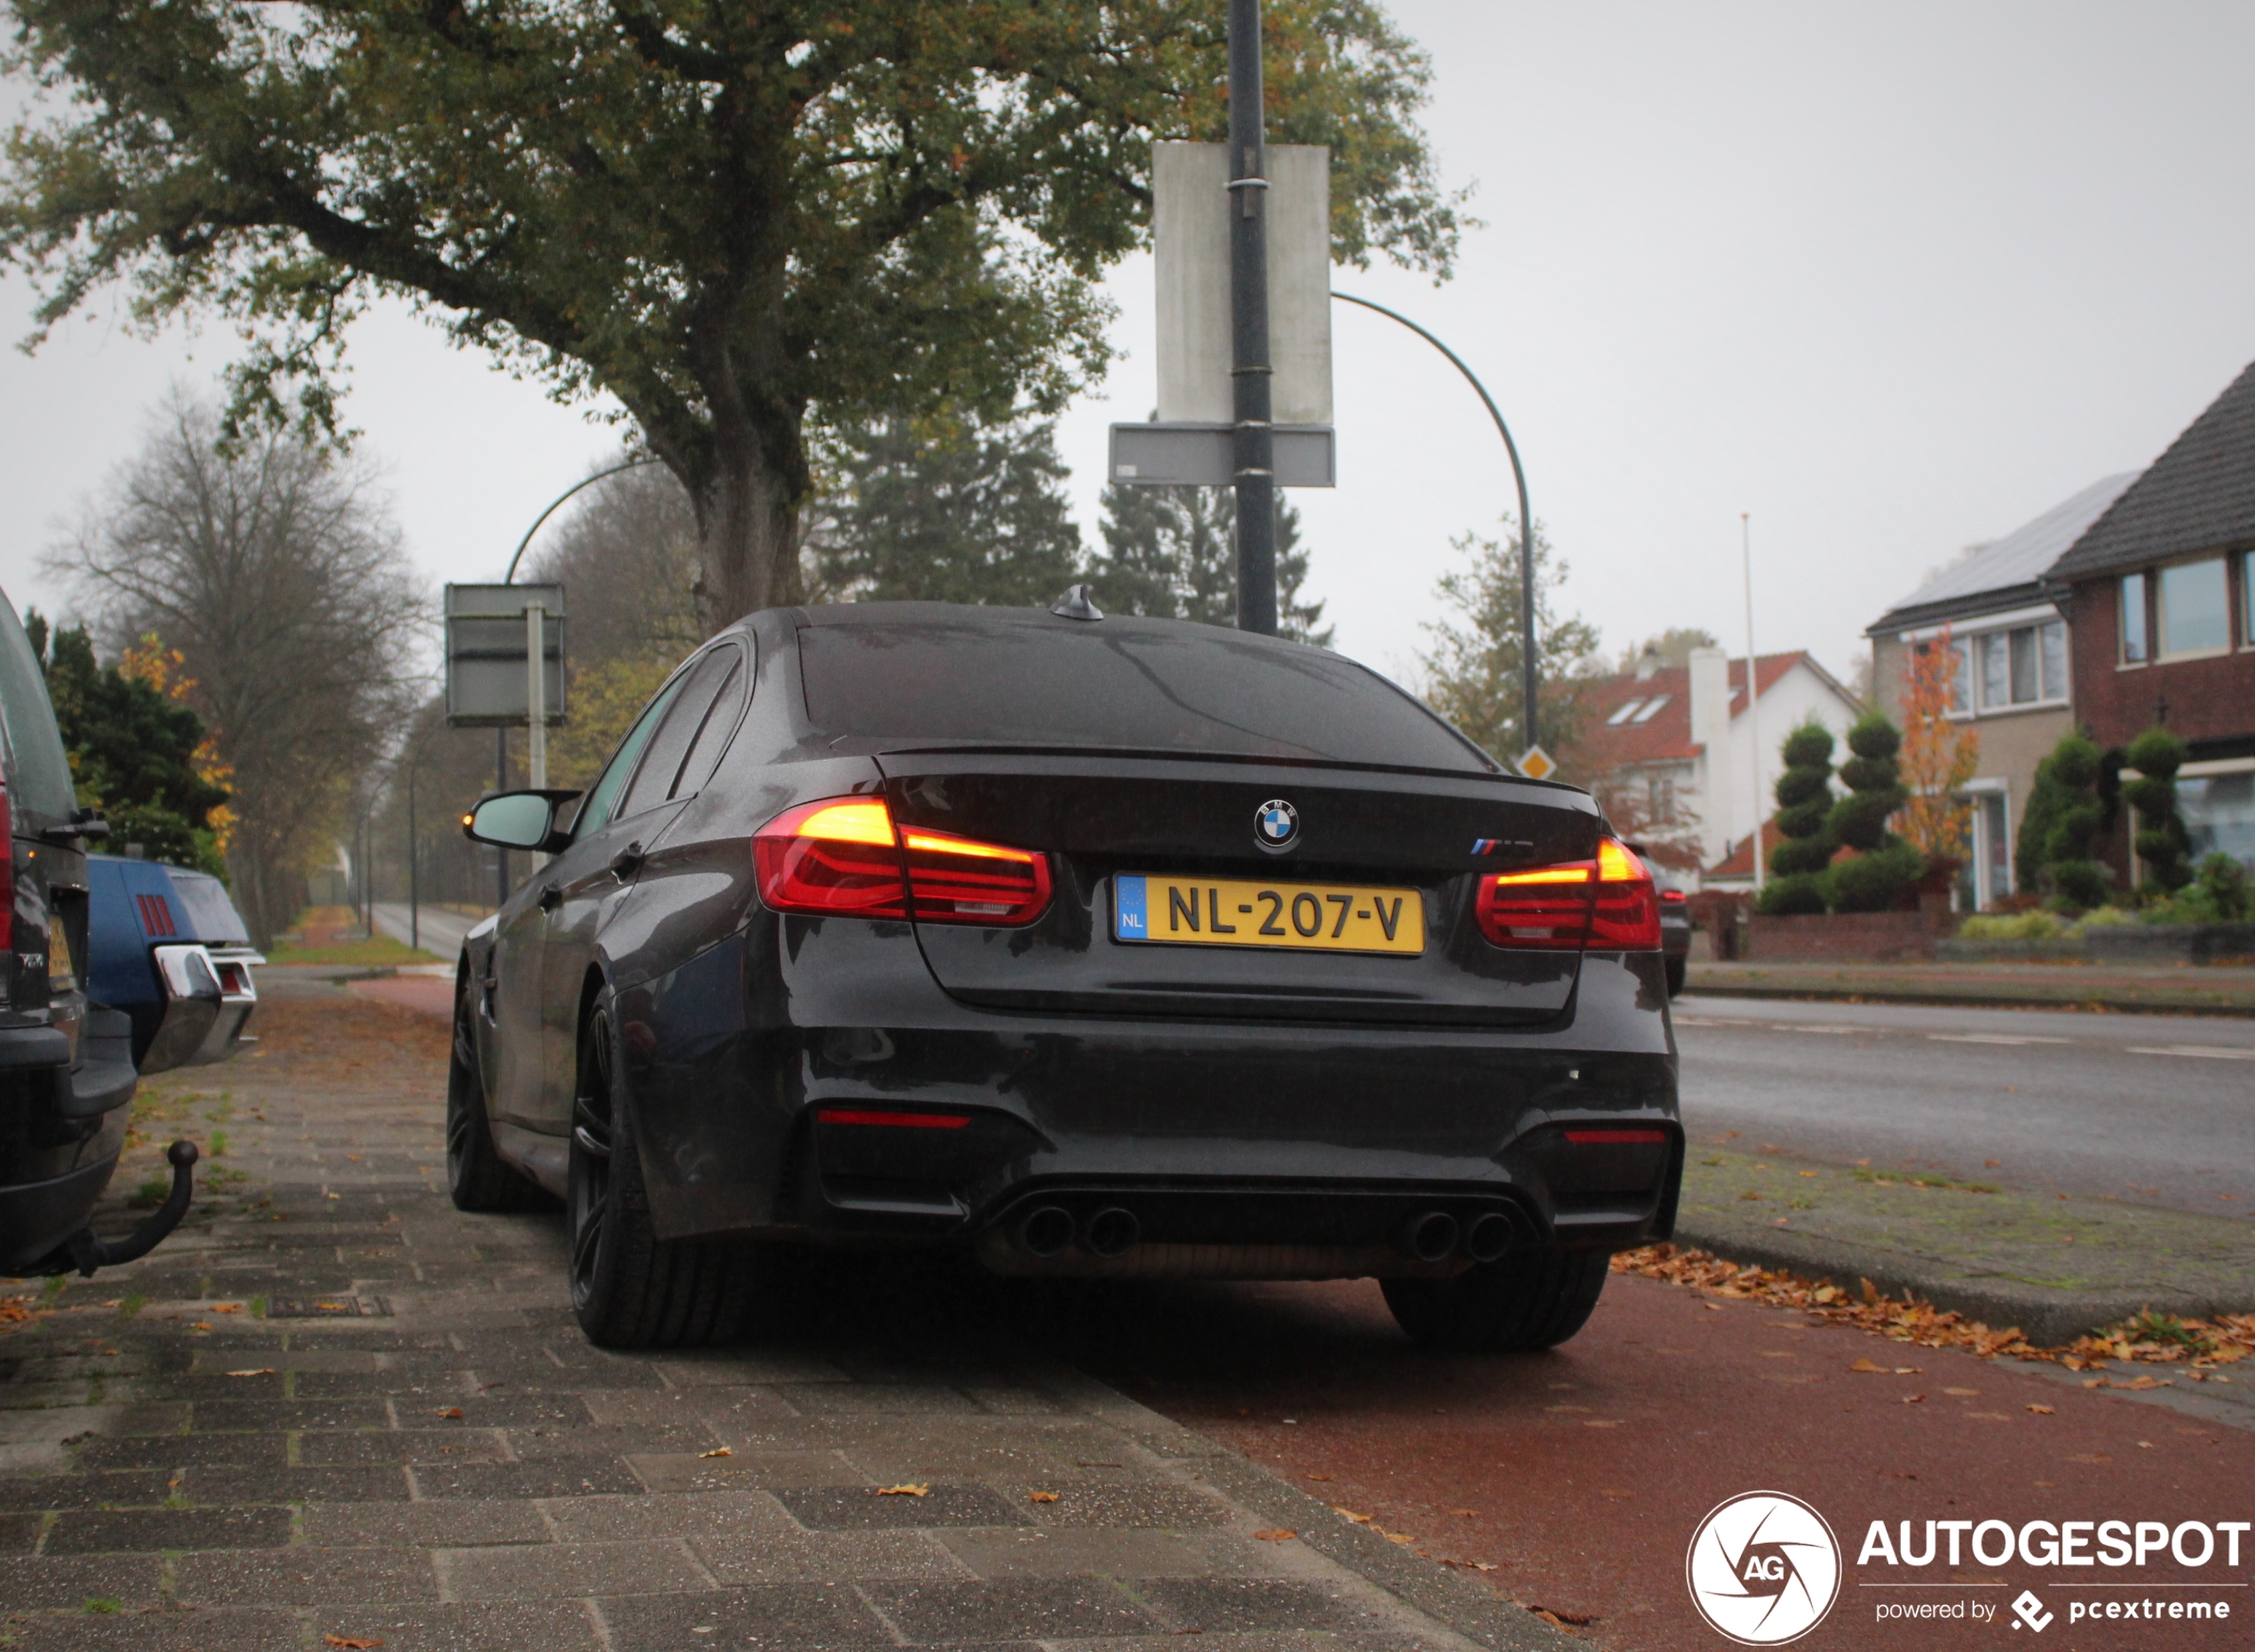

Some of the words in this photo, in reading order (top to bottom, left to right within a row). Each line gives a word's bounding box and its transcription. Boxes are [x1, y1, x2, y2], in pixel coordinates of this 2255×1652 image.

[1260, 801, 1296, 817] BMW
[1122, 913, 1143, 928] NL
[1168, 886, 1403, 941] NL-207-V
